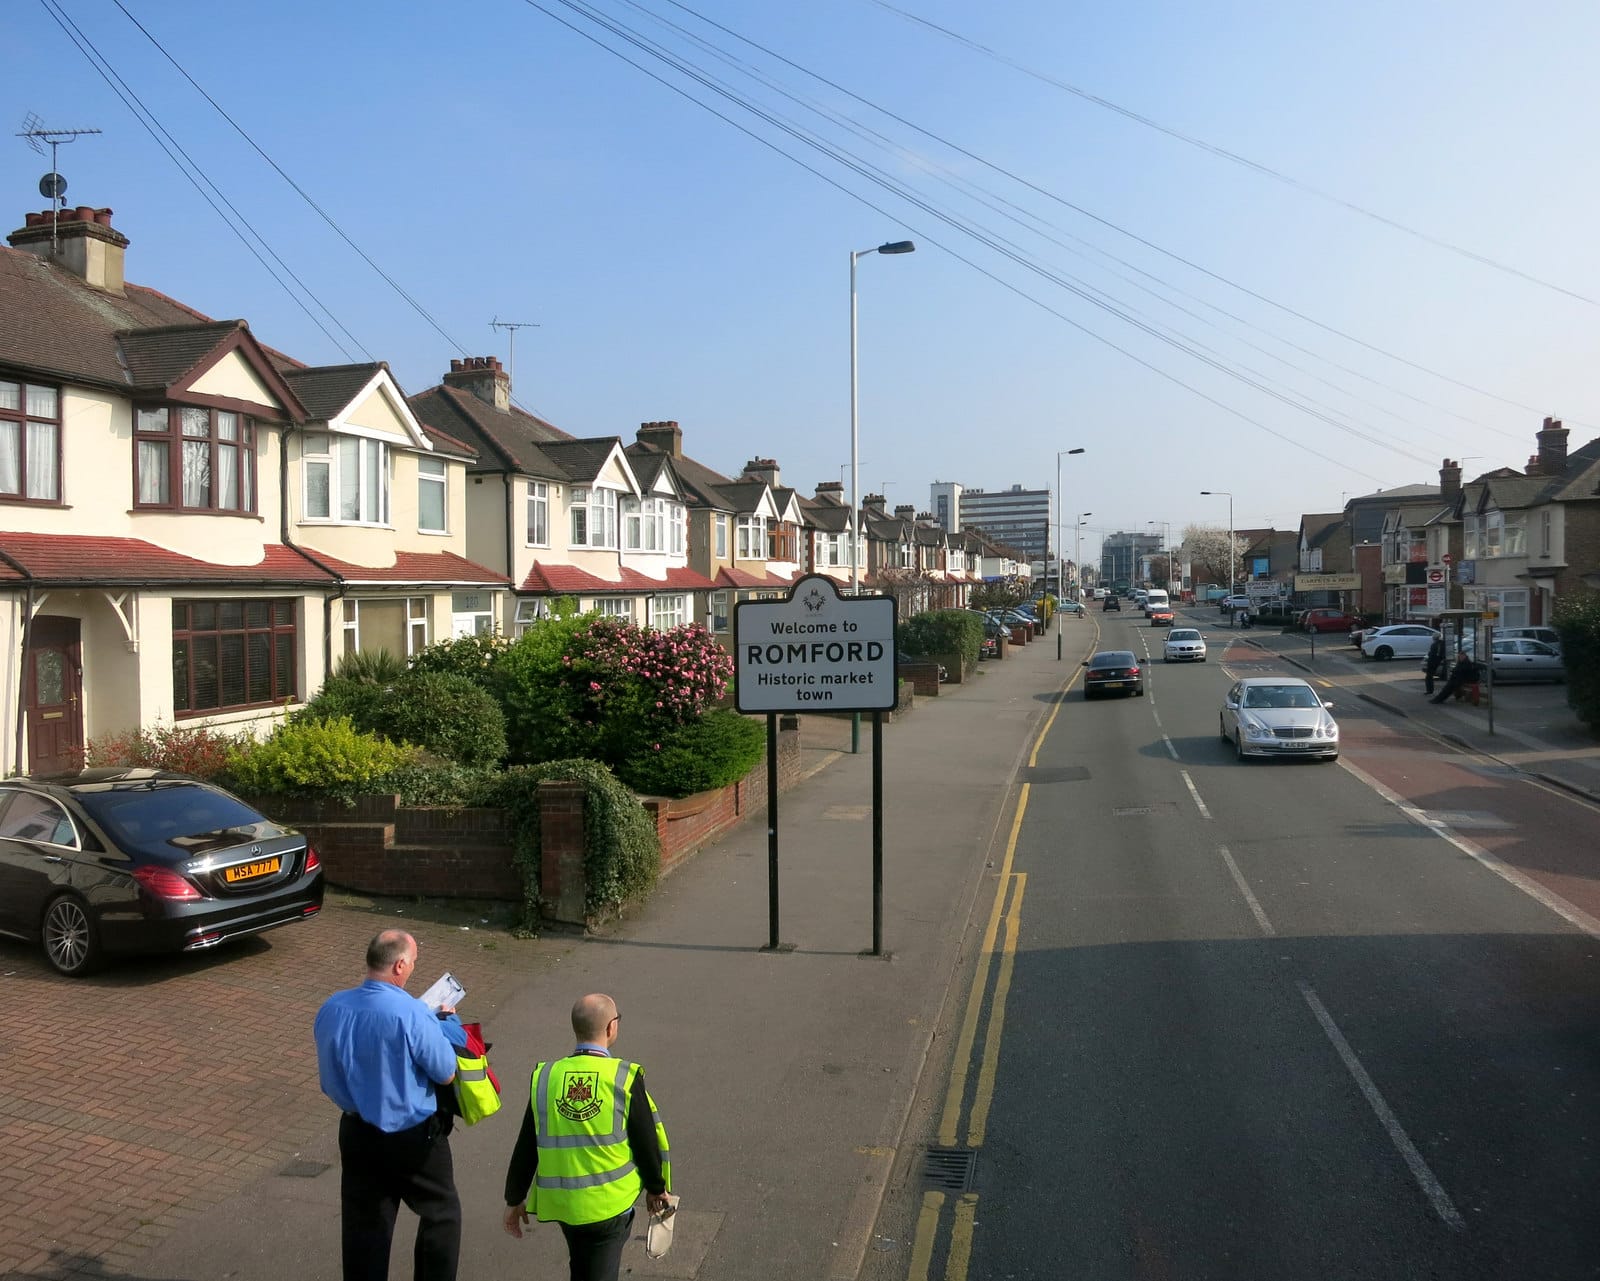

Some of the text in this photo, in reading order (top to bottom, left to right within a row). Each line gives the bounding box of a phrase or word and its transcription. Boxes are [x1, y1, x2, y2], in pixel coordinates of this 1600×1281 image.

[771, 620, 858, 634] Welcome to
[748, 641, 884, 665] ROMFORD
[758, 671, 874, 685] Historic market
[797, 688, 833, 701] town
[256, 861, 272, 873] 777
